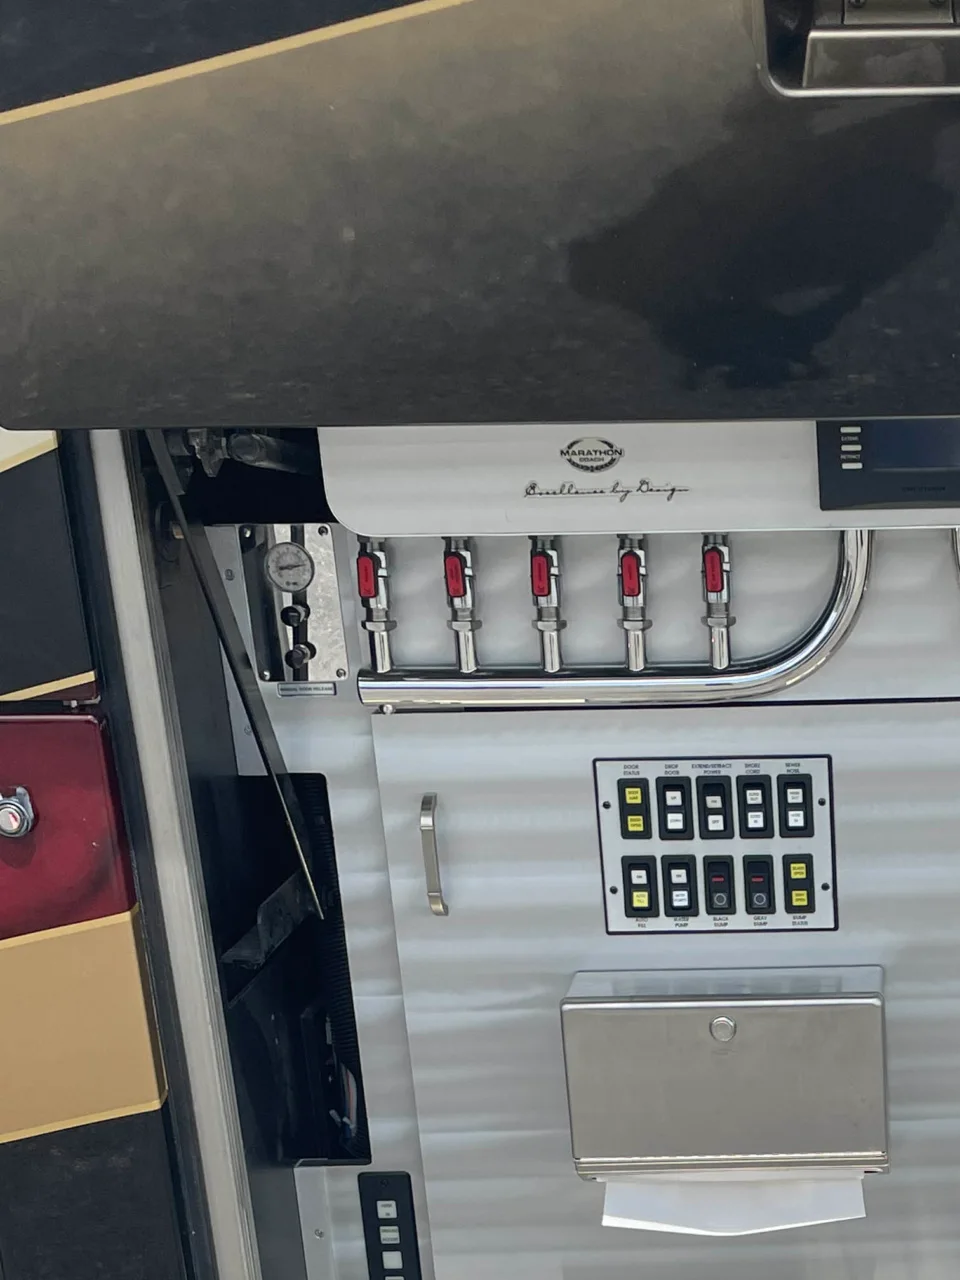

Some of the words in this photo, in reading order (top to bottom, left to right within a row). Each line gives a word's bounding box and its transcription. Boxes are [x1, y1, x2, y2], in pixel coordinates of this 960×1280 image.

[560, 449, 623, 457] MARATHON
[610, 481, 633, 503] by
[636, 479, 689, 502] Design
